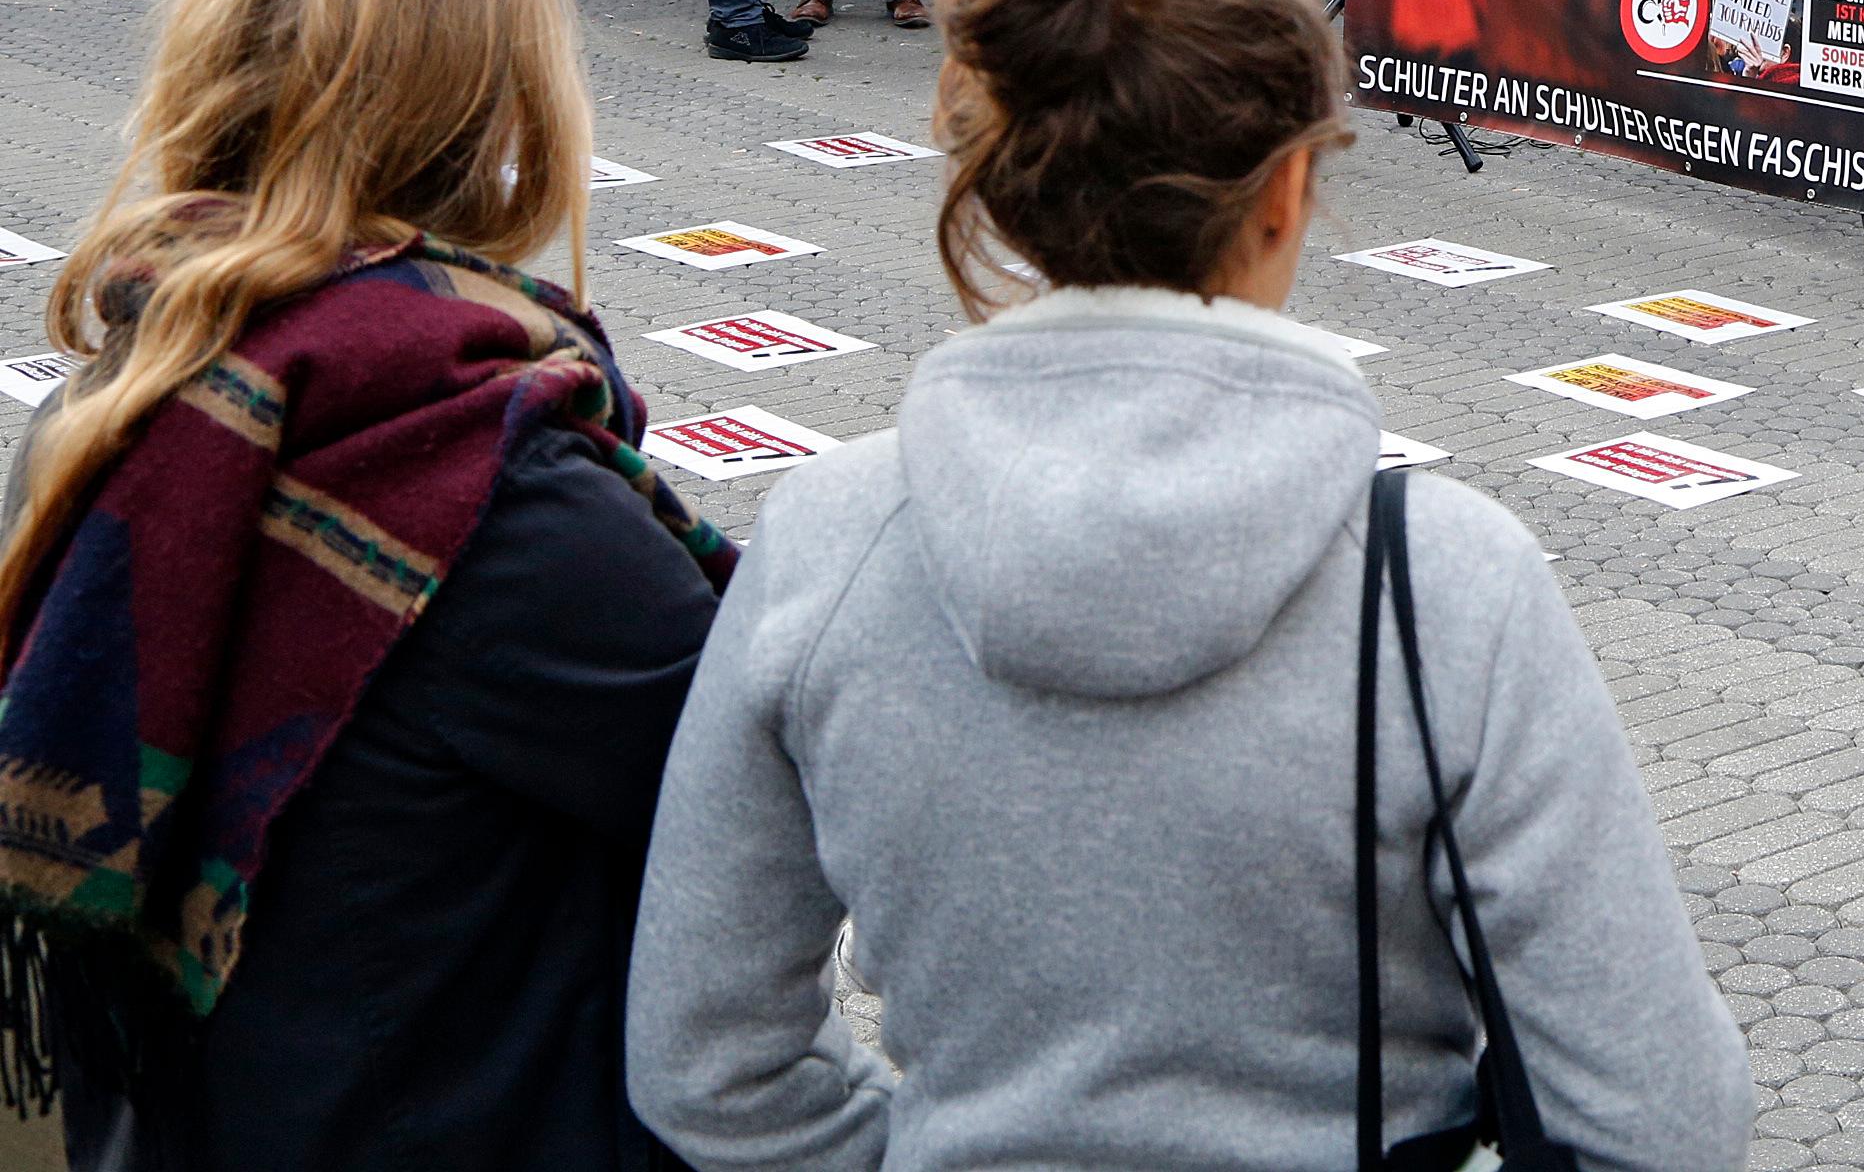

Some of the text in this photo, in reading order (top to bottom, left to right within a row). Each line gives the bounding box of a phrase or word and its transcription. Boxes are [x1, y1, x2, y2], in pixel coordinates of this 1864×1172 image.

[1835, 3, 1857, 21] IST
[1358, 54, 1489, 109] SCHULTER
[1493, 77, 1529, 117] AN
[1534, 84, 1654, 146] SCHULTER
[1654, 115, 1742, 167] GEGEN
